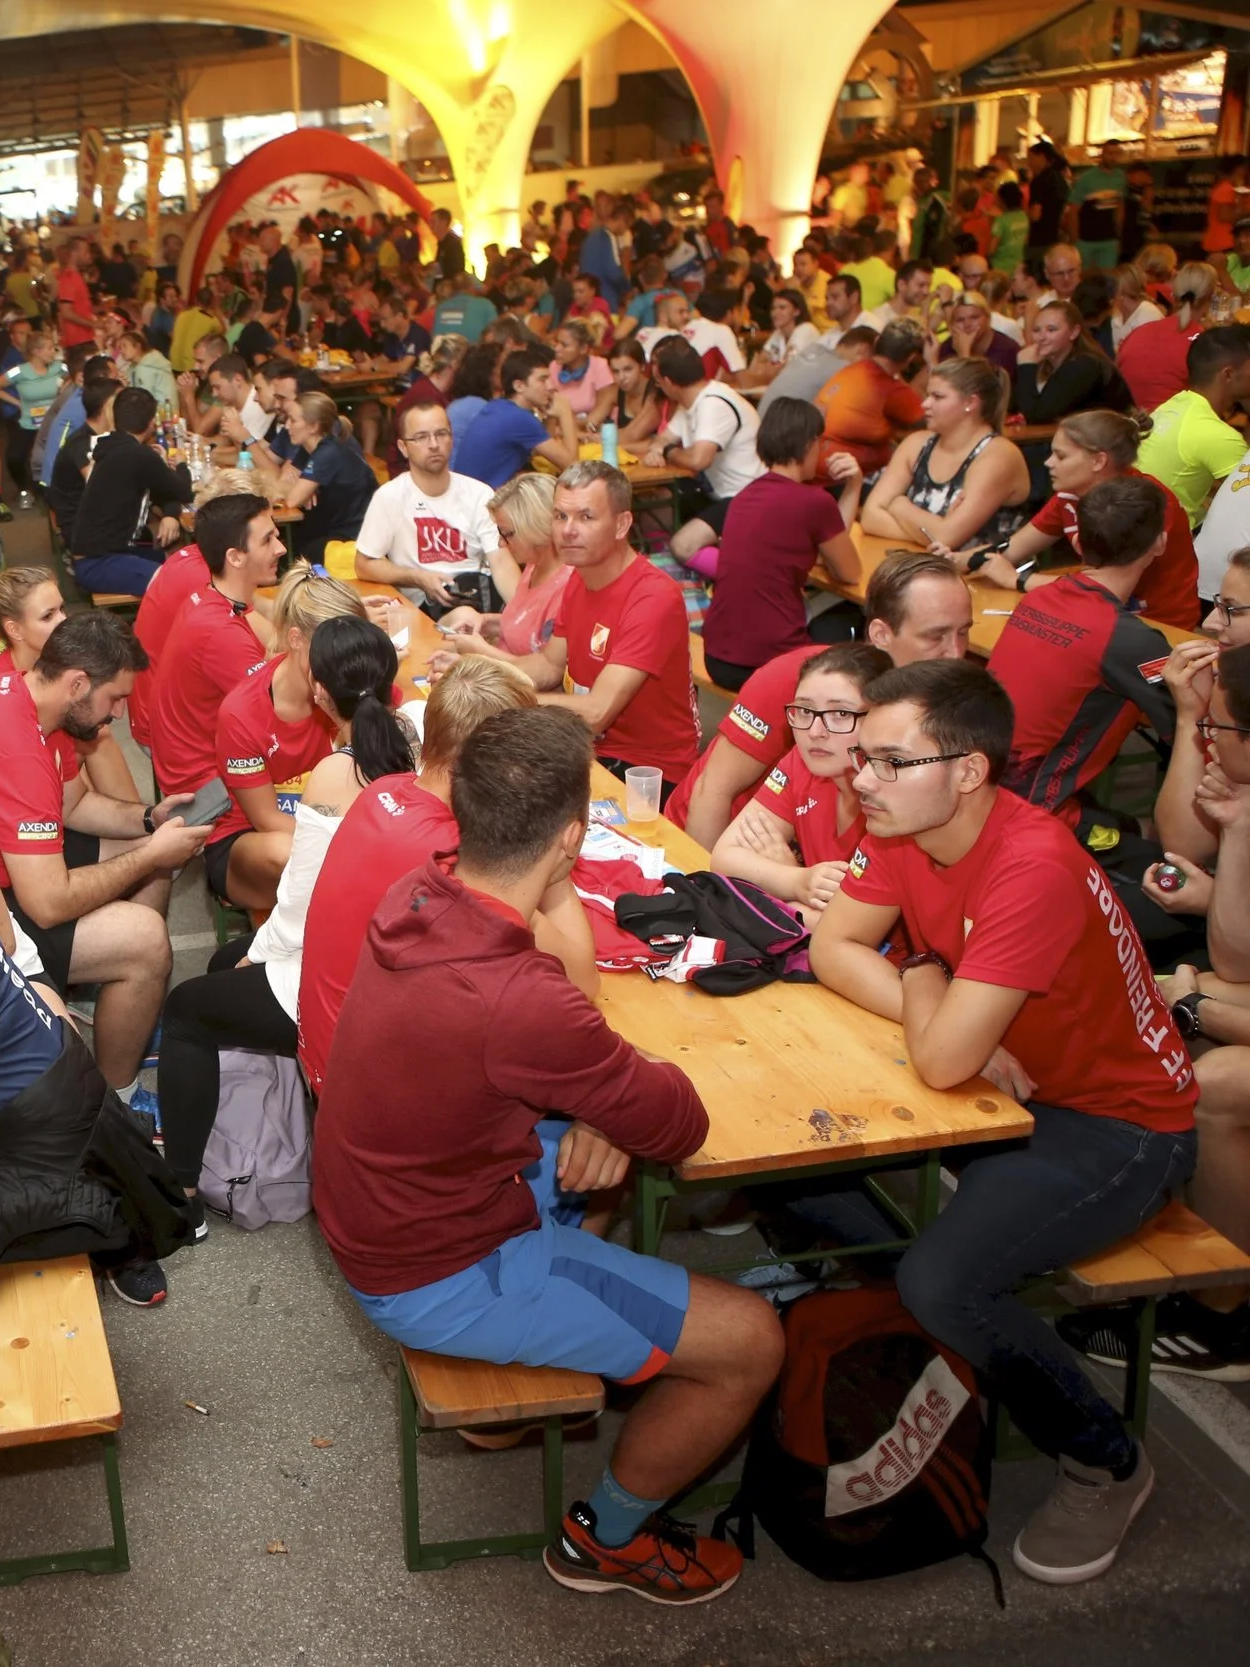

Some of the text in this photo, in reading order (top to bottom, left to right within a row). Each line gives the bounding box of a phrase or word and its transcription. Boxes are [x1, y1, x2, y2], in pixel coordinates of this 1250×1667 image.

[733, 703, 770, 735] AXENDA
[227, 756, 265, 768] AXENDA
[18, 822, 58, 832] AXENDA
[845, 1388, 952, 1502] adidas
